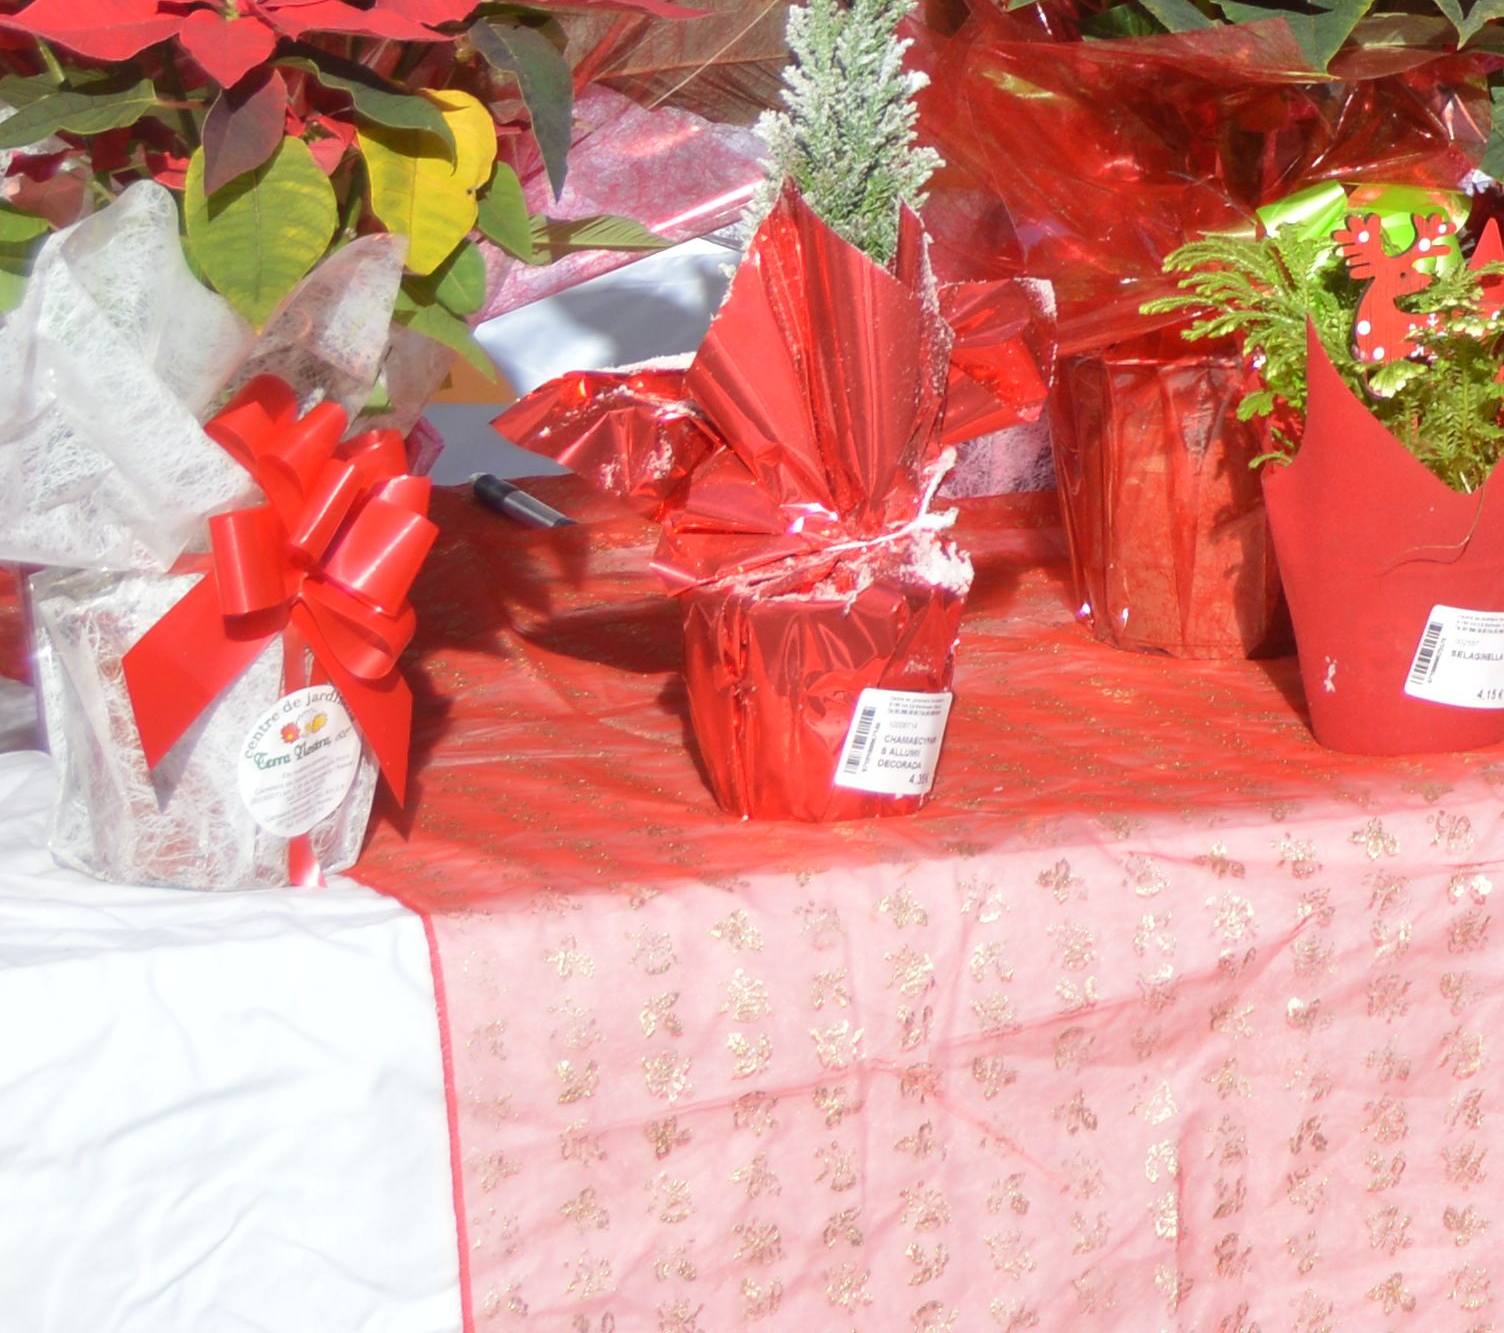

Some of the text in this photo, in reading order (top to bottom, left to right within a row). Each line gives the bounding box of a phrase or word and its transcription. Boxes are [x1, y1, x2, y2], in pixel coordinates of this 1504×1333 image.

[1450, 649, 1504, 662] SELAGINELLA
[244, 711, 280, 760] centre
[281, 697, 302, 714] de
[252, 751, 292, 771] Terra
